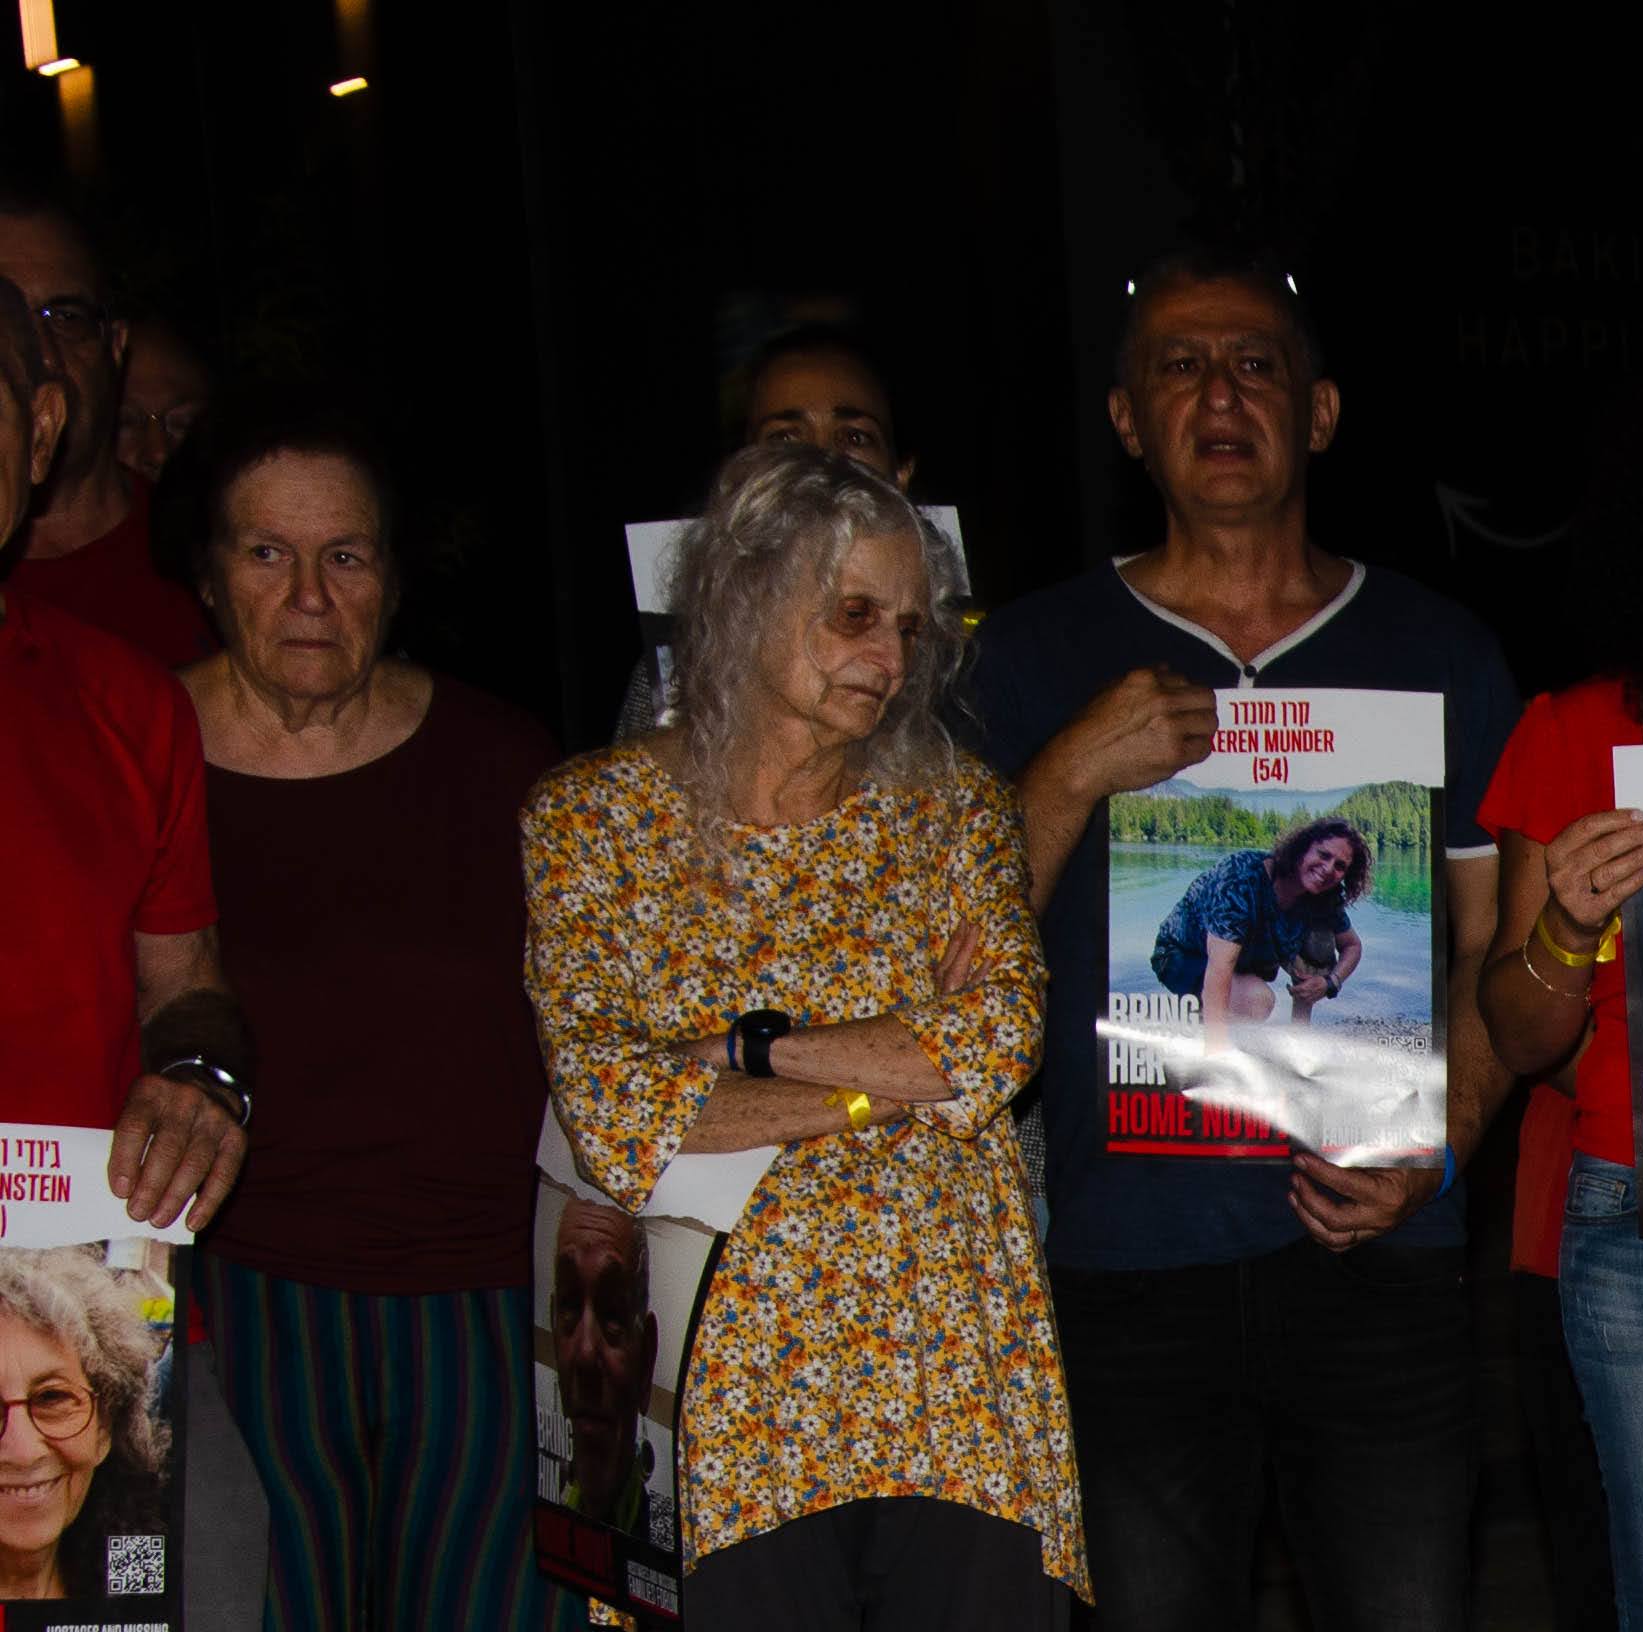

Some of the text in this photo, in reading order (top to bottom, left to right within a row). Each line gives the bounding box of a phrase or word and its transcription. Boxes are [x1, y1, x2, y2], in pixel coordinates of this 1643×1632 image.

[1229, 702, 1310, 727] קרן מונדר
[1265, 730, 1334, 752] MUNDER
[1252, 757, 1289, 783] (54)
[1108, 1091, 1192, 1137] HOME
